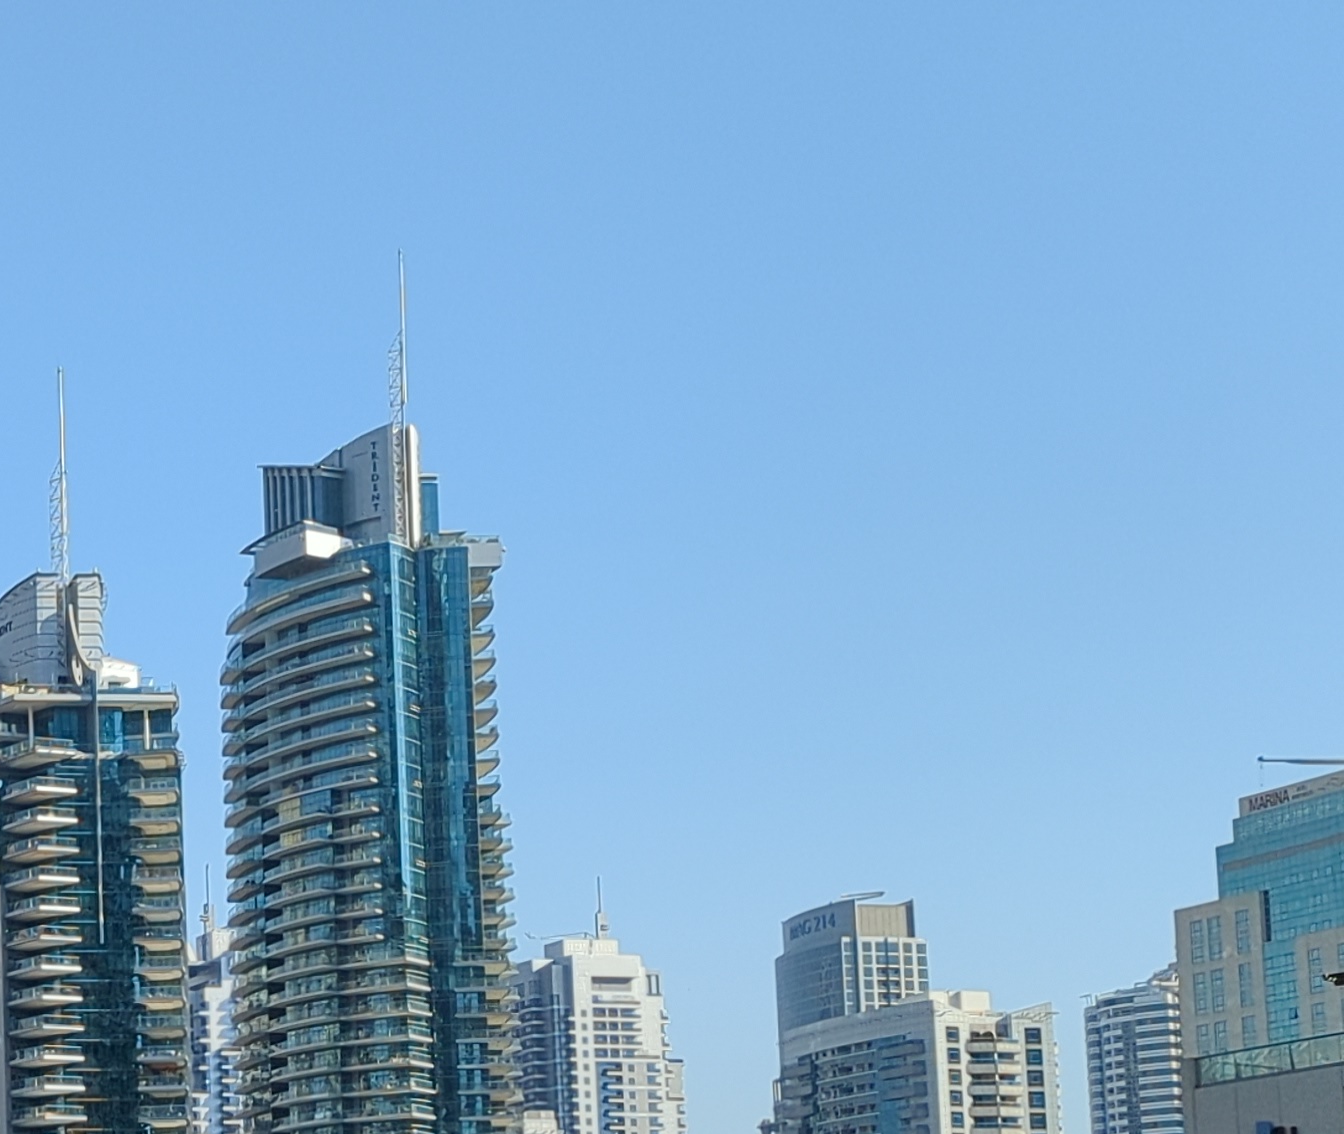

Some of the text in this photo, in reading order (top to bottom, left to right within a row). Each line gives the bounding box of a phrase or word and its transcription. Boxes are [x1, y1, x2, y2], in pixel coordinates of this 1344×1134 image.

[370, 441, 381, 512] TRIDENT
[1248, 789, 1290, 812] MARINA
[813, 913, 836, 933] 214
